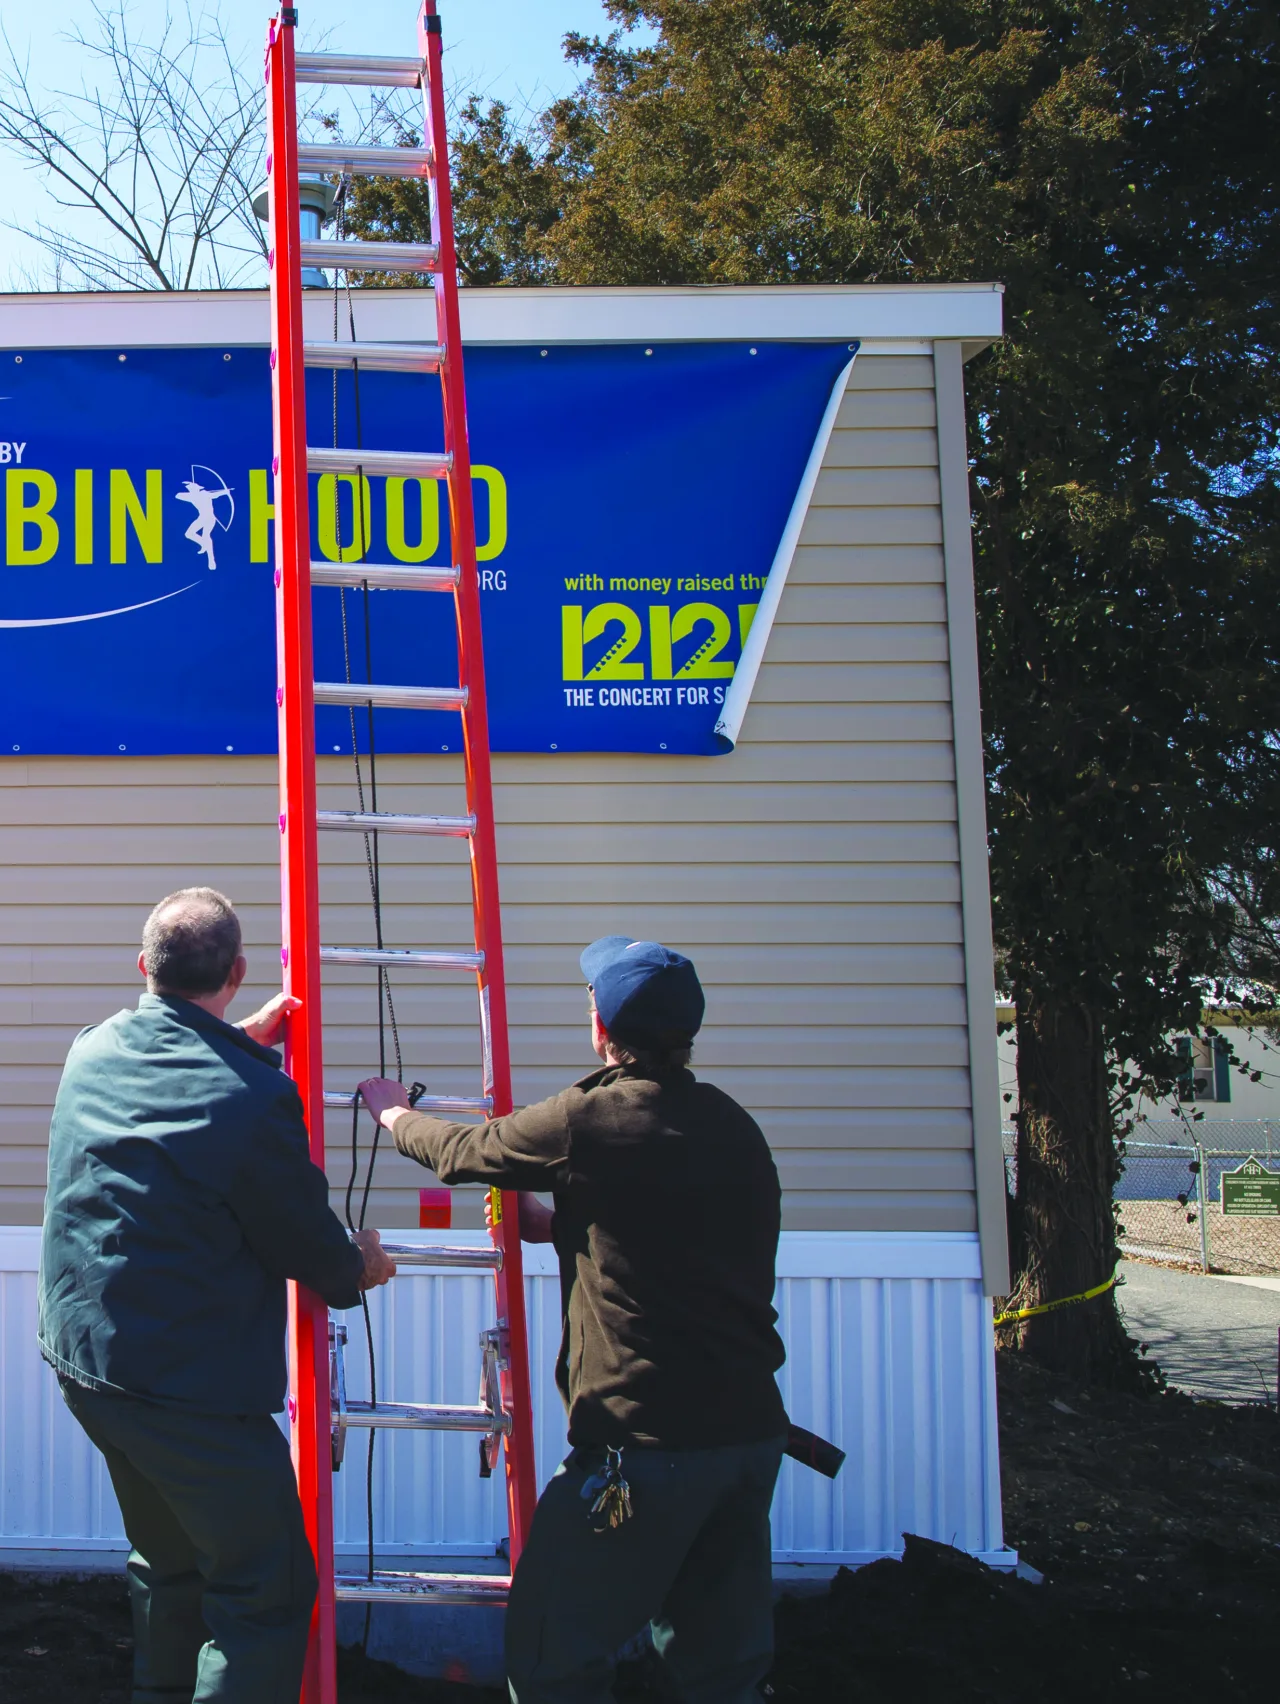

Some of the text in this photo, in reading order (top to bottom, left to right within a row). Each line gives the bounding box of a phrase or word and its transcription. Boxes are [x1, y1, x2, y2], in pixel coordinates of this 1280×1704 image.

[564, 573, 604, 591] with
[609, 577, 672, 595] money
[677, 573, 735, 591] raised
[561, 602, 759, 681] 1212
[563, 688, 595, 707] THE
[598, 687, 672, 706] CONCERT
[676, 687, 710, 706] FOR
